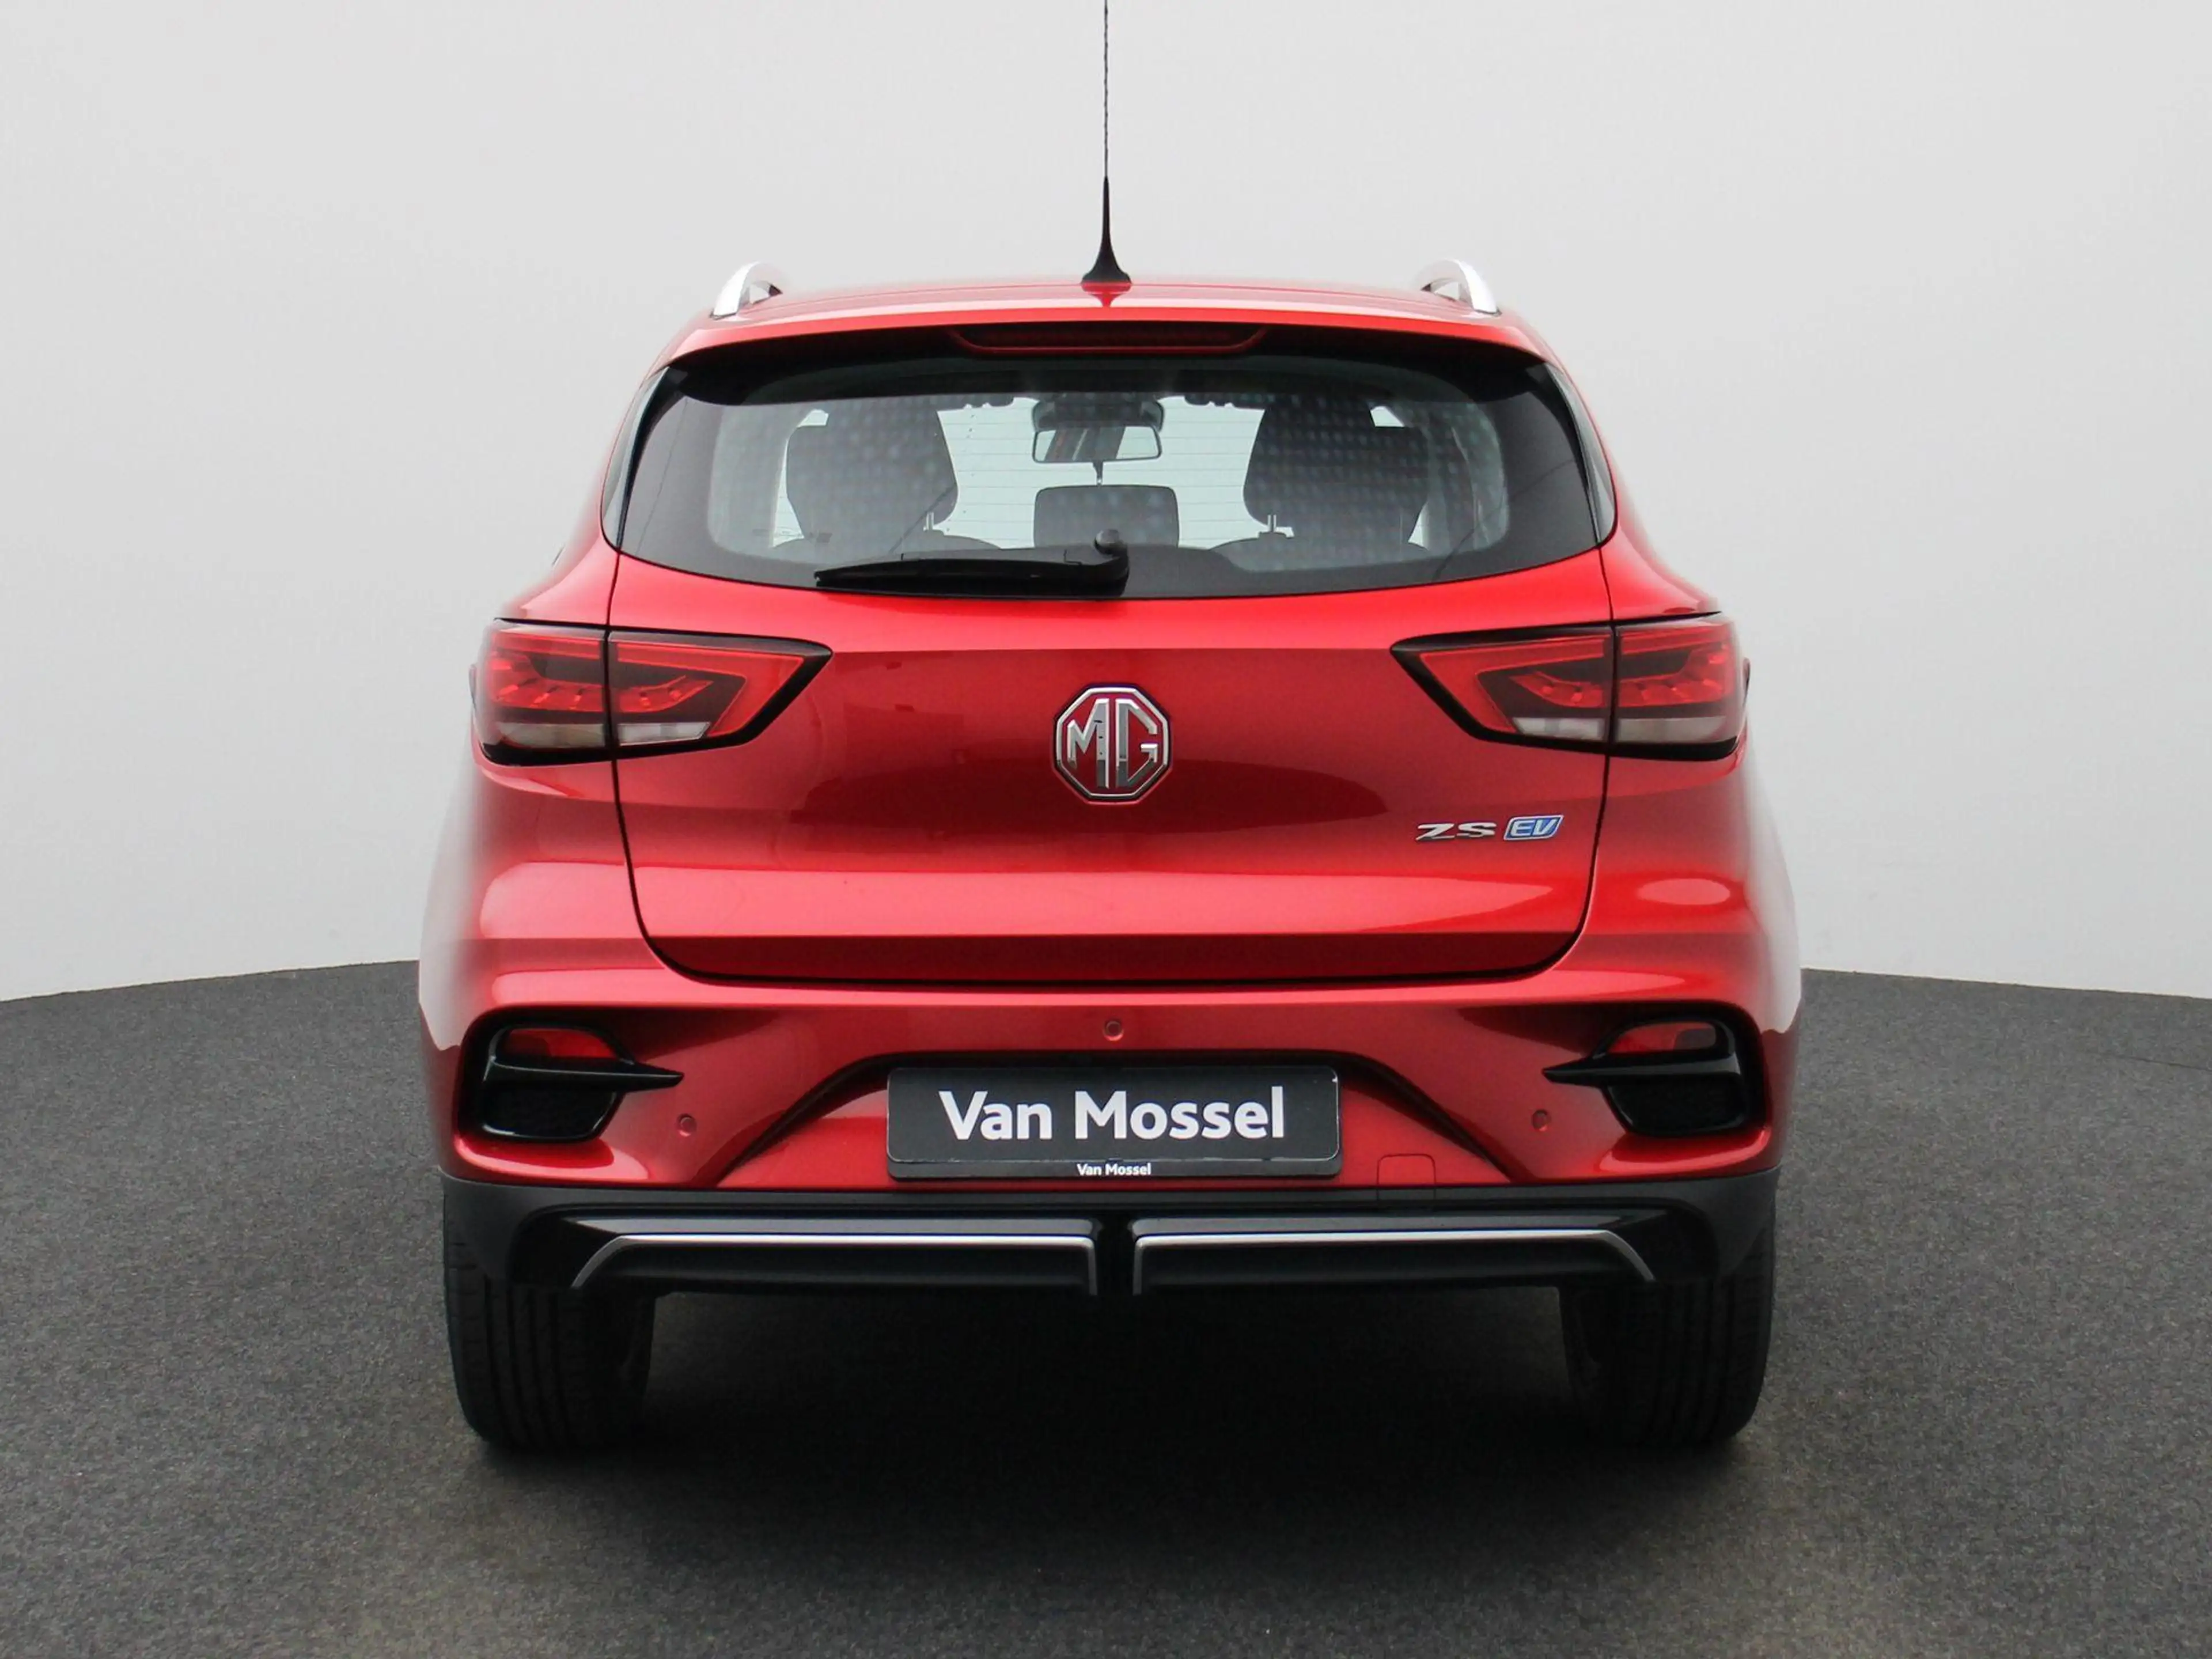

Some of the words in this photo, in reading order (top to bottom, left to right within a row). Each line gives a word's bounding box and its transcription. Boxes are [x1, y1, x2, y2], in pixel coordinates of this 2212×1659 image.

[1067, 698, 1158, 789] MG
[1415, 821, 1498, 840] ZS
[1509, 818, 1556, 837] EV
[938, 1090, 1052, 1140] Van
[1074, 1085, 1285, 1139] Mossel
[1077, 1163, 1102, 1176] Van
[1105, 1162, 1152, 1176] Mossel
